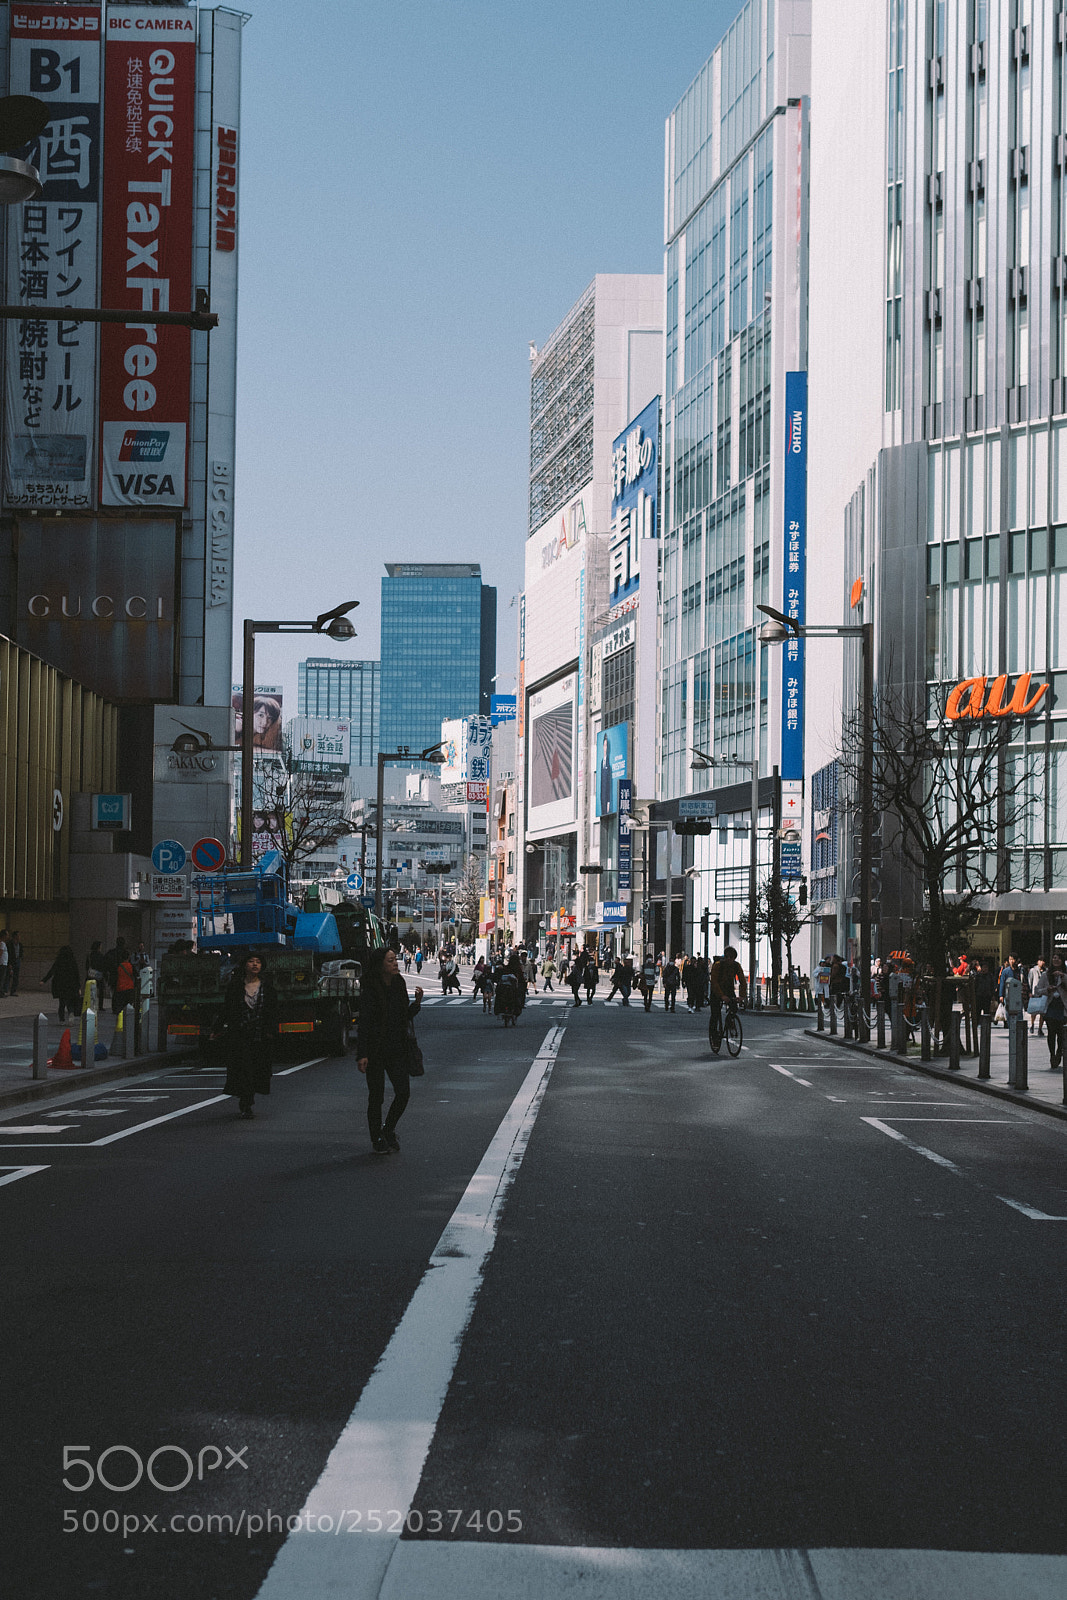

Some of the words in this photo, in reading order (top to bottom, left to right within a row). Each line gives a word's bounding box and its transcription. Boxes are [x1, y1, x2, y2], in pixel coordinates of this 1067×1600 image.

[13, 14, 99, 31] ビックカメラ
[109, 18, 131, 30] BIC
[135, 18, 194, 31] CAMERA
[30, 48, 80, 93] B1
[125, 57, 144, 153] 快速免税手续
[147, 48, 175, 164] QUICK
[19, 205, 49, 428] 日本酒焼酎など
[52, 207, 83, 412] ワインビール
[123, 437, 166, 449] UnionPay
[792, 410, 803, 454] MIZUHO
[112, 474, 175, 495] VISA
[213, 460, 230, 501] BIC
[610, 425, 653, 502] 洋服の
[6, 493, 89, 505] ビックポイントサービス
[211, 504, 230, 608] CAMERA
[607, 487, 653, 596] 青山
[788, 520, 800, 573] みずほ証券
[27, 594, 163, 619] GUCCI
[787, 589, 799, 662] みずほ銀行
[787, 677, 799, 730] みずほ銀行
[945, 672, 1050, 720] au
[317, 742, 343, 752] 英会話
[159, 849, 173, 870] P
[168, 860, 179, 871] 40
